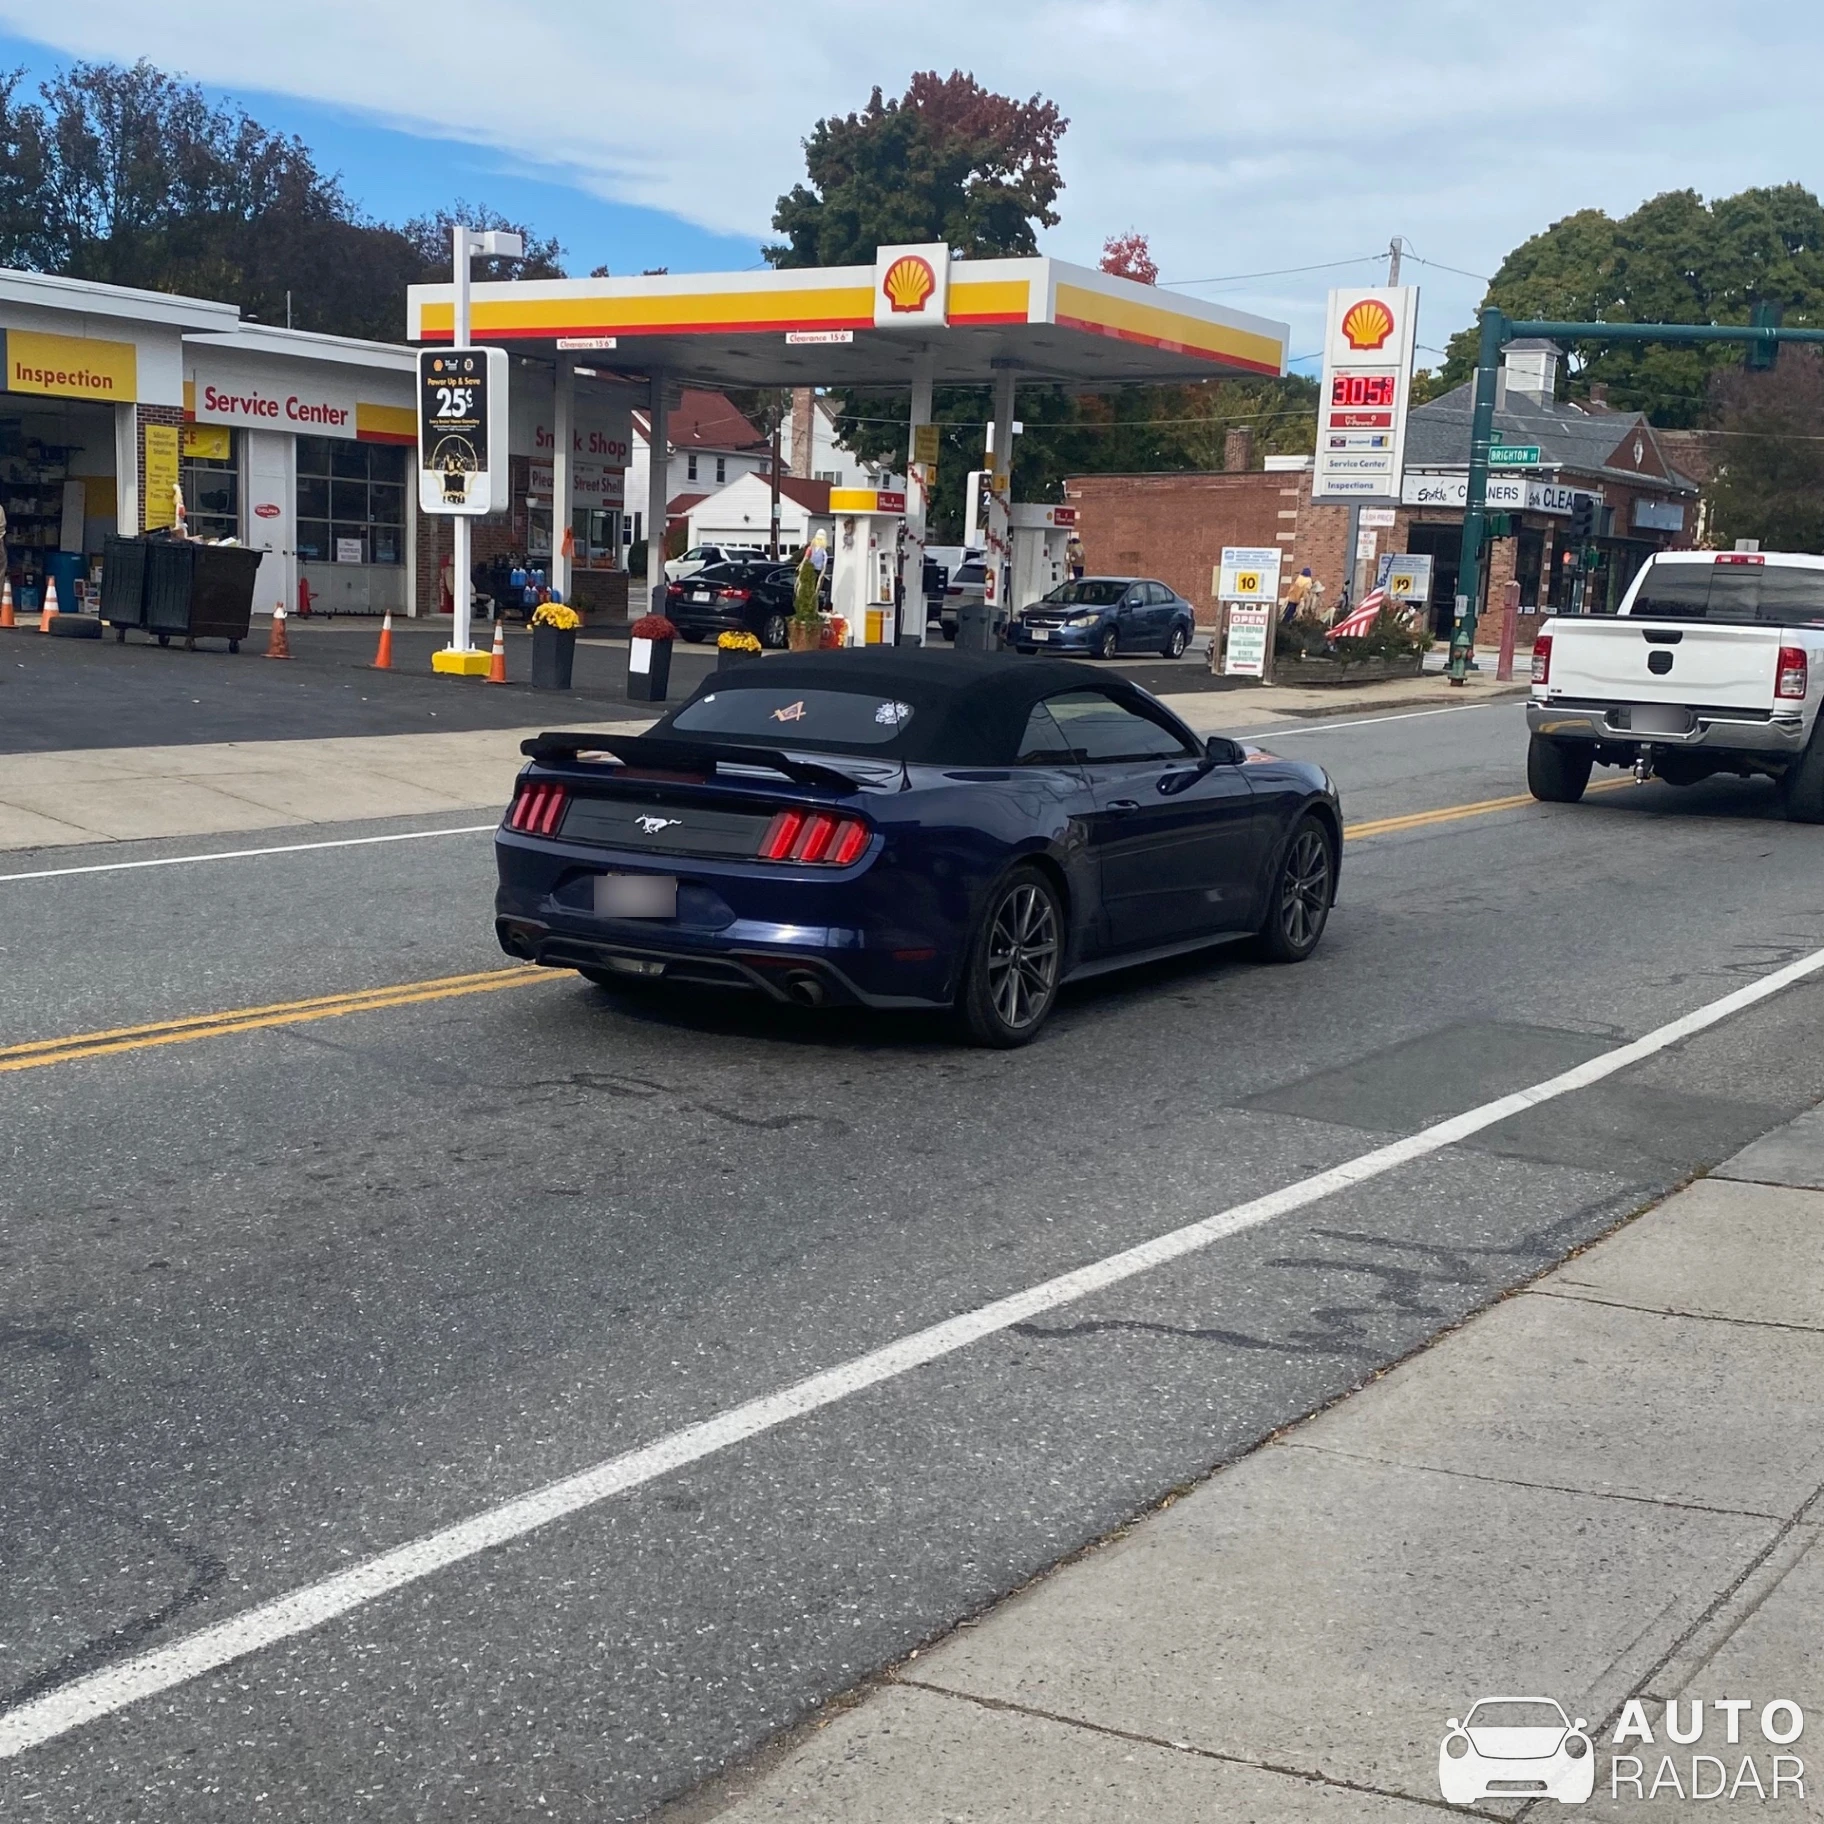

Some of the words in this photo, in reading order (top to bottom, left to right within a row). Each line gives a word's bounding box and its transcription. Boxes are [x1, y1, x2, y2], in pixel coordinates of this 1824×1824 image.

[559, 340, 593, 348] Clearance
[789, 334, 827, 342] Clearance
[16, 362, 113, 389] Inspection
[427, 378, 447, 386] Power
[447, 378, 458, 387] Up
[458, 377, 464, 385] &
[464, 377, 481, 385] Save
[1333, 378, 1383, 405] 3.05
[205, 385, 279, 417] Service
[285, 396, 349, 426] Center
[536, 426, 583, 451] Snk
[589, 431, 627, 462] Shop
[1491, 450, 1529, 461] BRIGHTON
[1329, 460, 1358, 468] Service
[1359, 460, 1386, 468] Center
[573, 474, 600, 492] Street
[601, 478, 622, 494] Shell
[1328, 481, 1374, 490] Inspections
[1457, 485, 1518, 500] CNERS
[1543, 488, 1573, 510] CLEA
[1241, 576, 1256, 590] 10
[1397, 579, 1410, 590] 10
[1232, 615, 1265, 624] OPEN
